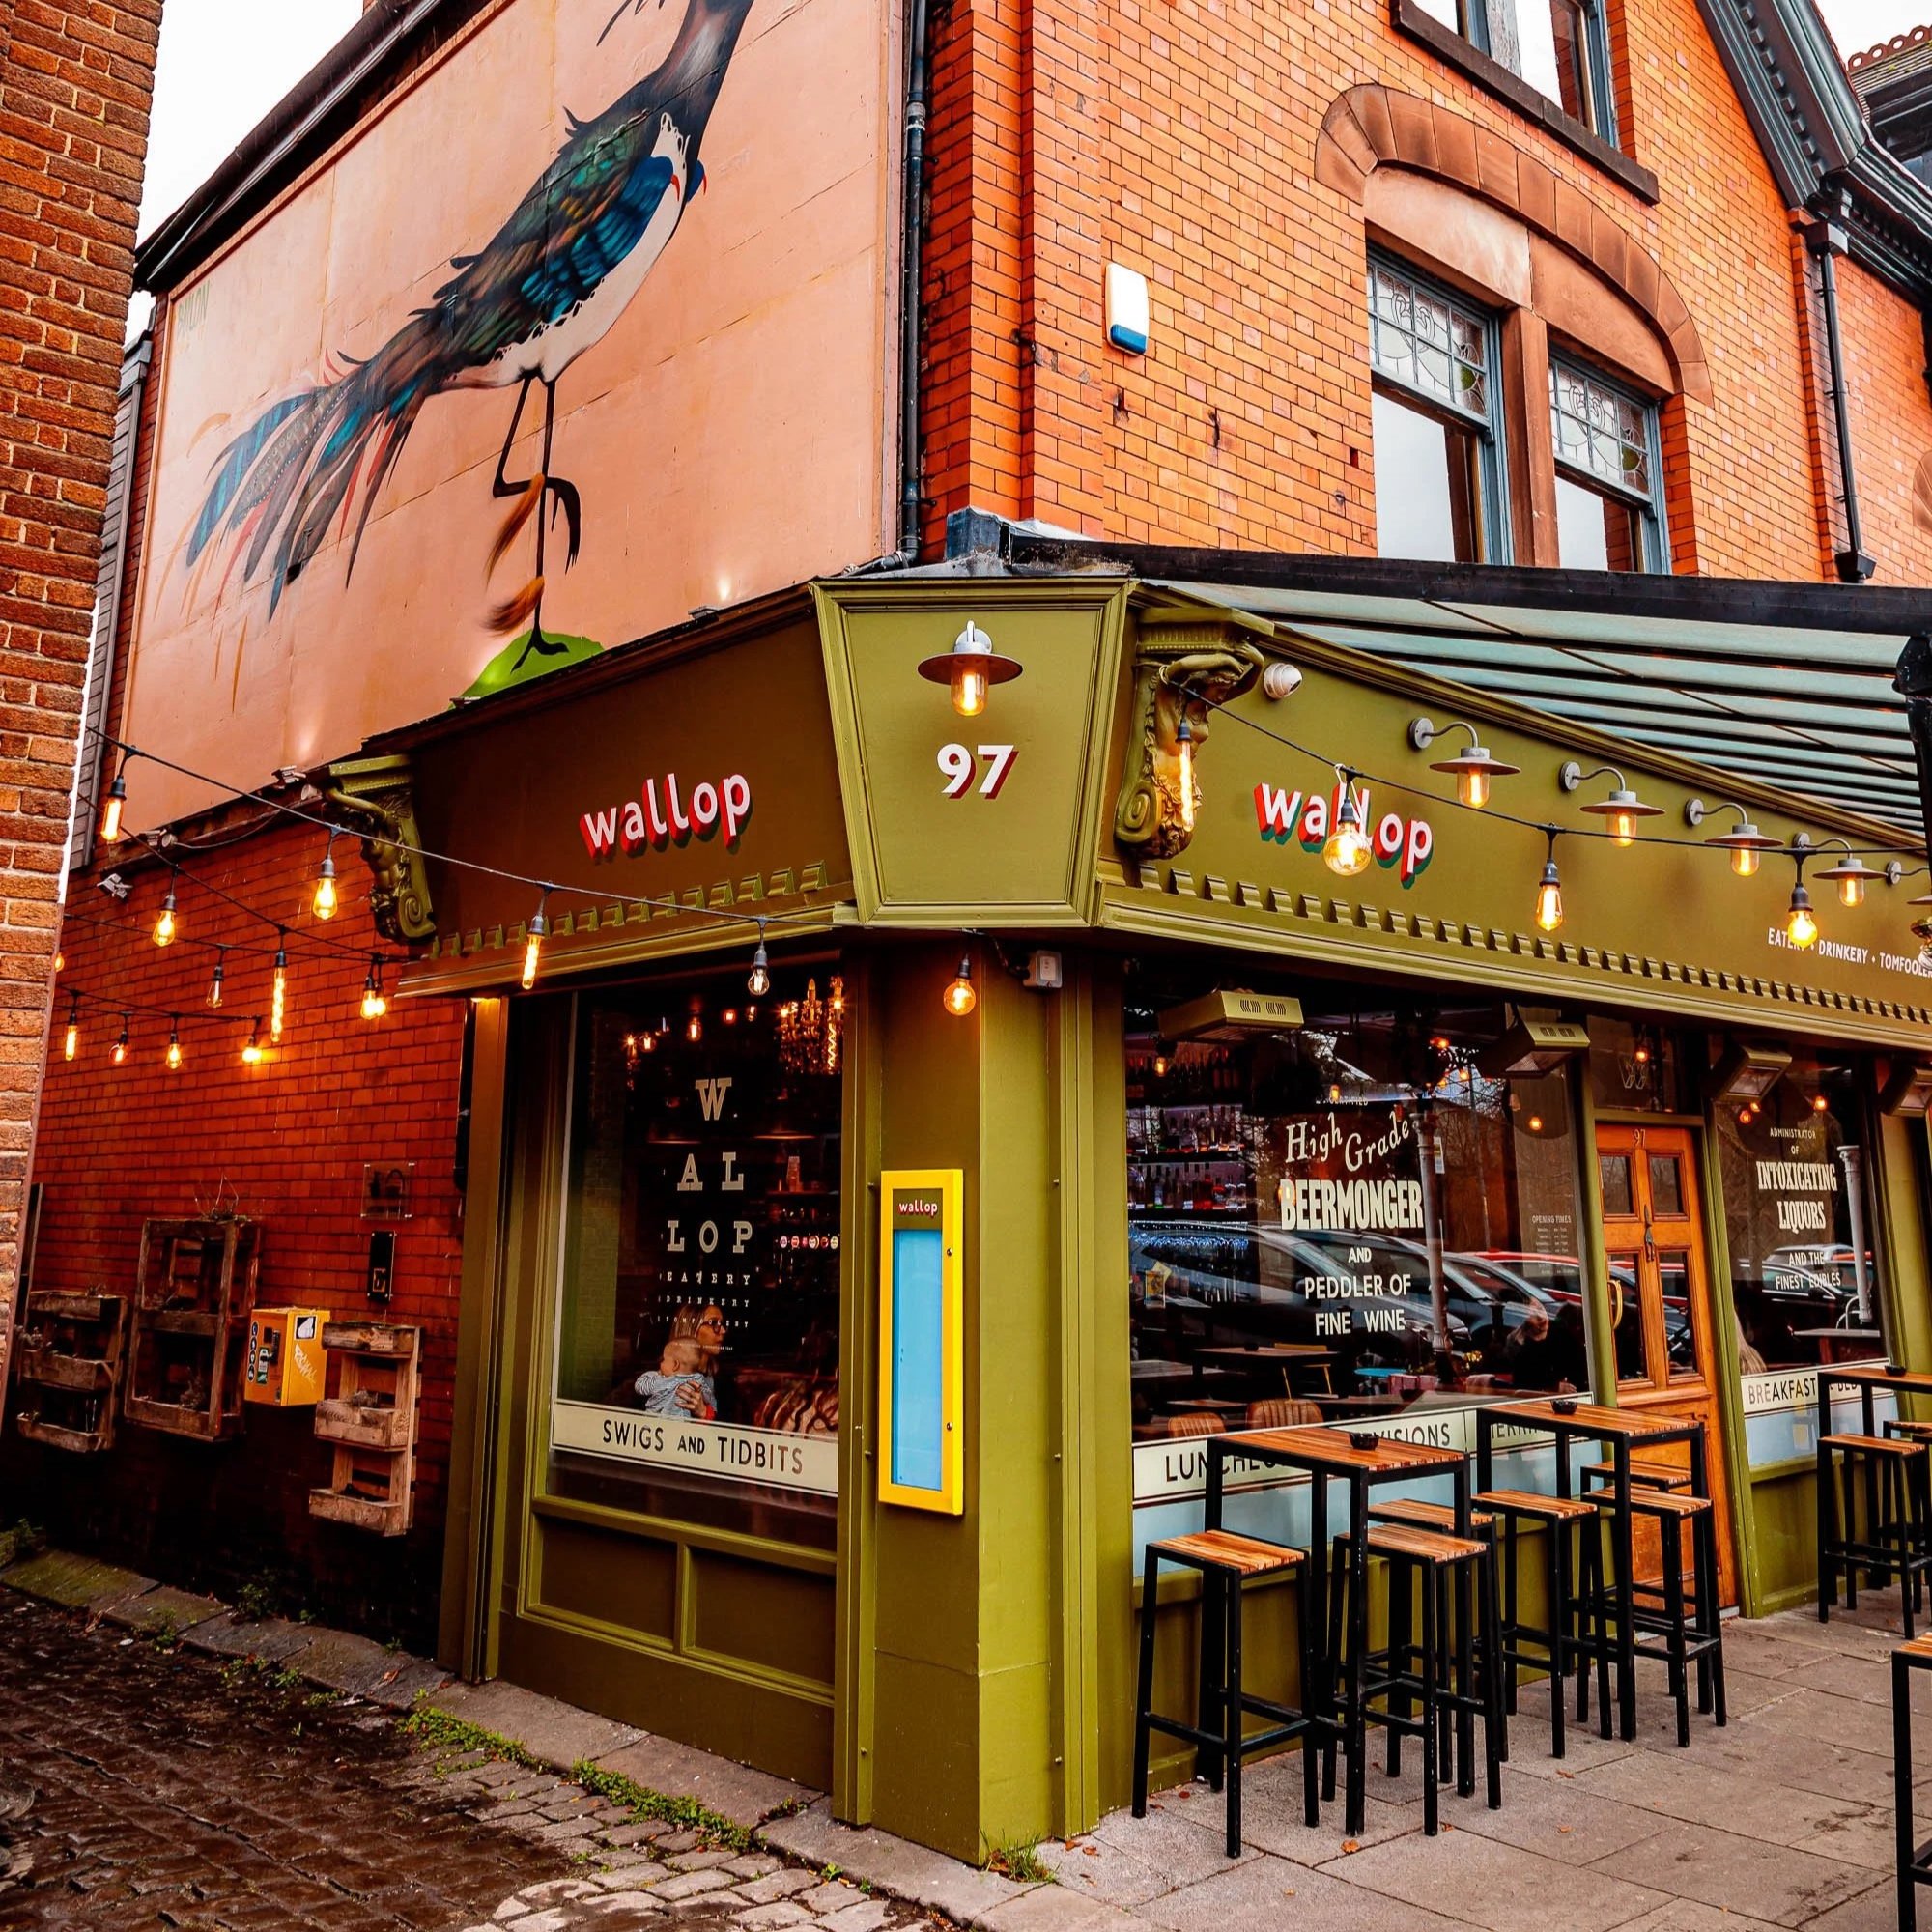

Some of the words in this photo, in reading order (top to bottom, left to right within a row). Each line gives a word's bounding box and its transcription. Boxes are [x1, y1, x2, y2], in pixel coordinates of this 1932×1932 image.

[937, 743, 1019, 800] 97
[580, 772, 753, 857] wallop
[1254, 781, 1434, 884] wallop
[1768, 927, 1806, 952] EAT
[1818, 939, 1868, 964] DRINKERY
[695, 1077, 732, 1121] W
[1285, 1112, 1343, 1163] High
[1345, 1111, 1409, 1172] Grade
[1634, 1128, 1646, 1149] 97
[1770, 1127, 1817, 1140] ADMINISTRATOR
[1791, 1145, 1800, 1155] OF
[1756, 1161, 1838, 1191] INTOXICATING
[898, 1199, 938, 1217] wallop
[1280, 1179, 1424, 1230] BEERMONGER
[1777, 1201, 1827, 1234] LIQUORS
[1532, 1215, 1554, 1224] OPENING
[1555, 1215, 1572, 1224] TIMES
[1348, 1247, 1372, 1264] AND
[1789, 1252, 1806, 1267] AND
[1808, 1251, 1825, 1266] THE
[667, 1271, 751, 1286] EATERY
[1304, 1275, 1383, 1300] PEDDLER
[1389, 1273, 1411, 1296] OF
[1776, 1275, 1804, 1291] FINEST
[1808, 1272, 1841, 1289] EDIBLES
[1315, 1311, 1351, 1336] FINE
[1363, 1308, 1406, 1333] WINE
[1747, 1378, 1816, 1405] BREAKFAST
[603, 1419, 664, 1452] SWIGS
[677, 1435, 705, 1455] AND
[717, 1436, 803, 1475] TIDBITS
